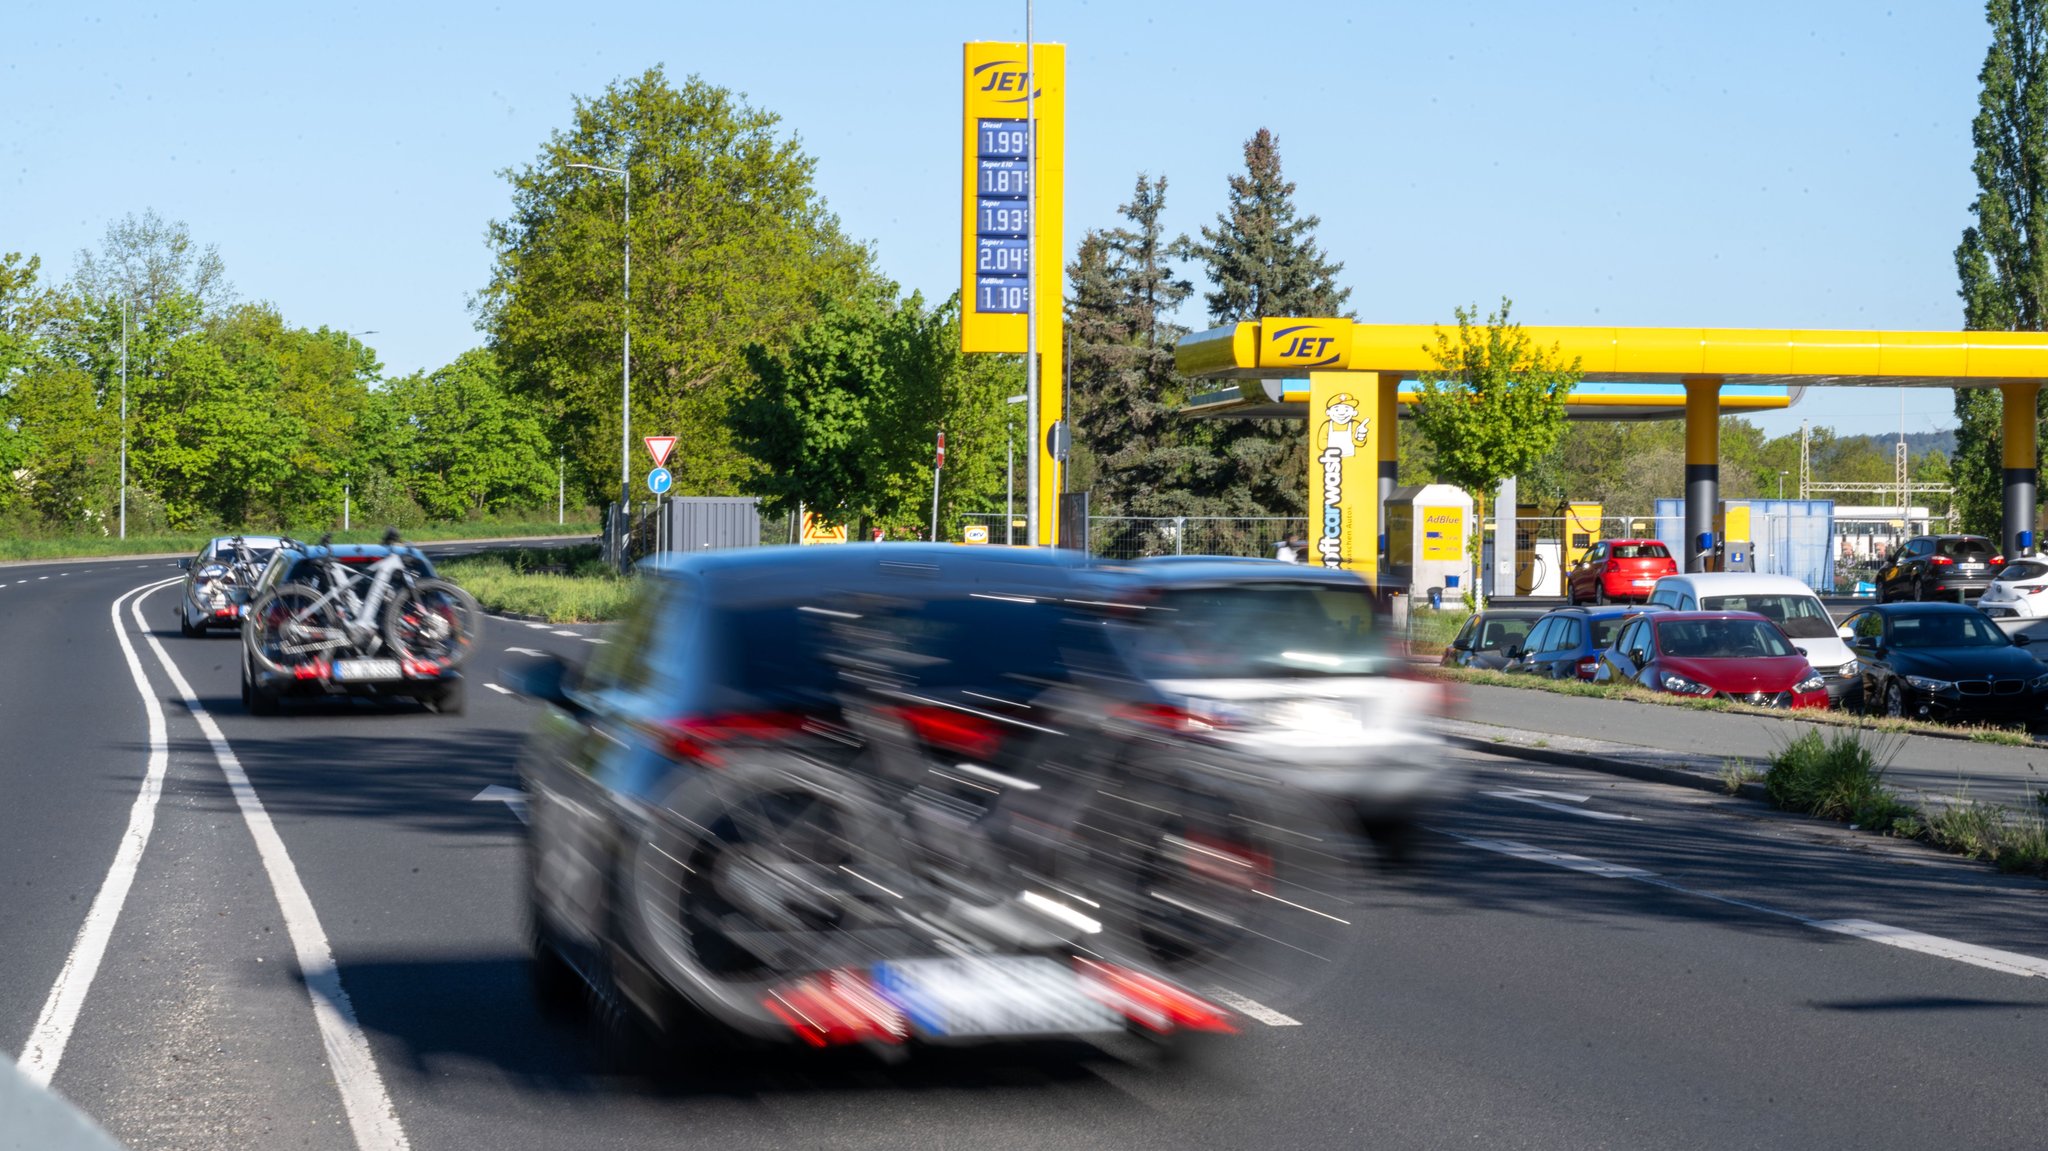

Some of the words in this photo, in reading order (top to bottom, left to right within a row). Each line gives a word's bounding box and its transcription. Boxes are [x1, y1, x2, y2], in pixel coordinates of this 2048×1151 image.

[981, 72, 1035, 91] JET
[982, 161, 1001, 169] Super
[981, 200, 1000, 208] Super
[1279, 337, 1334, 358] JET
[1426, 515, 1460, 524] AdBlue
